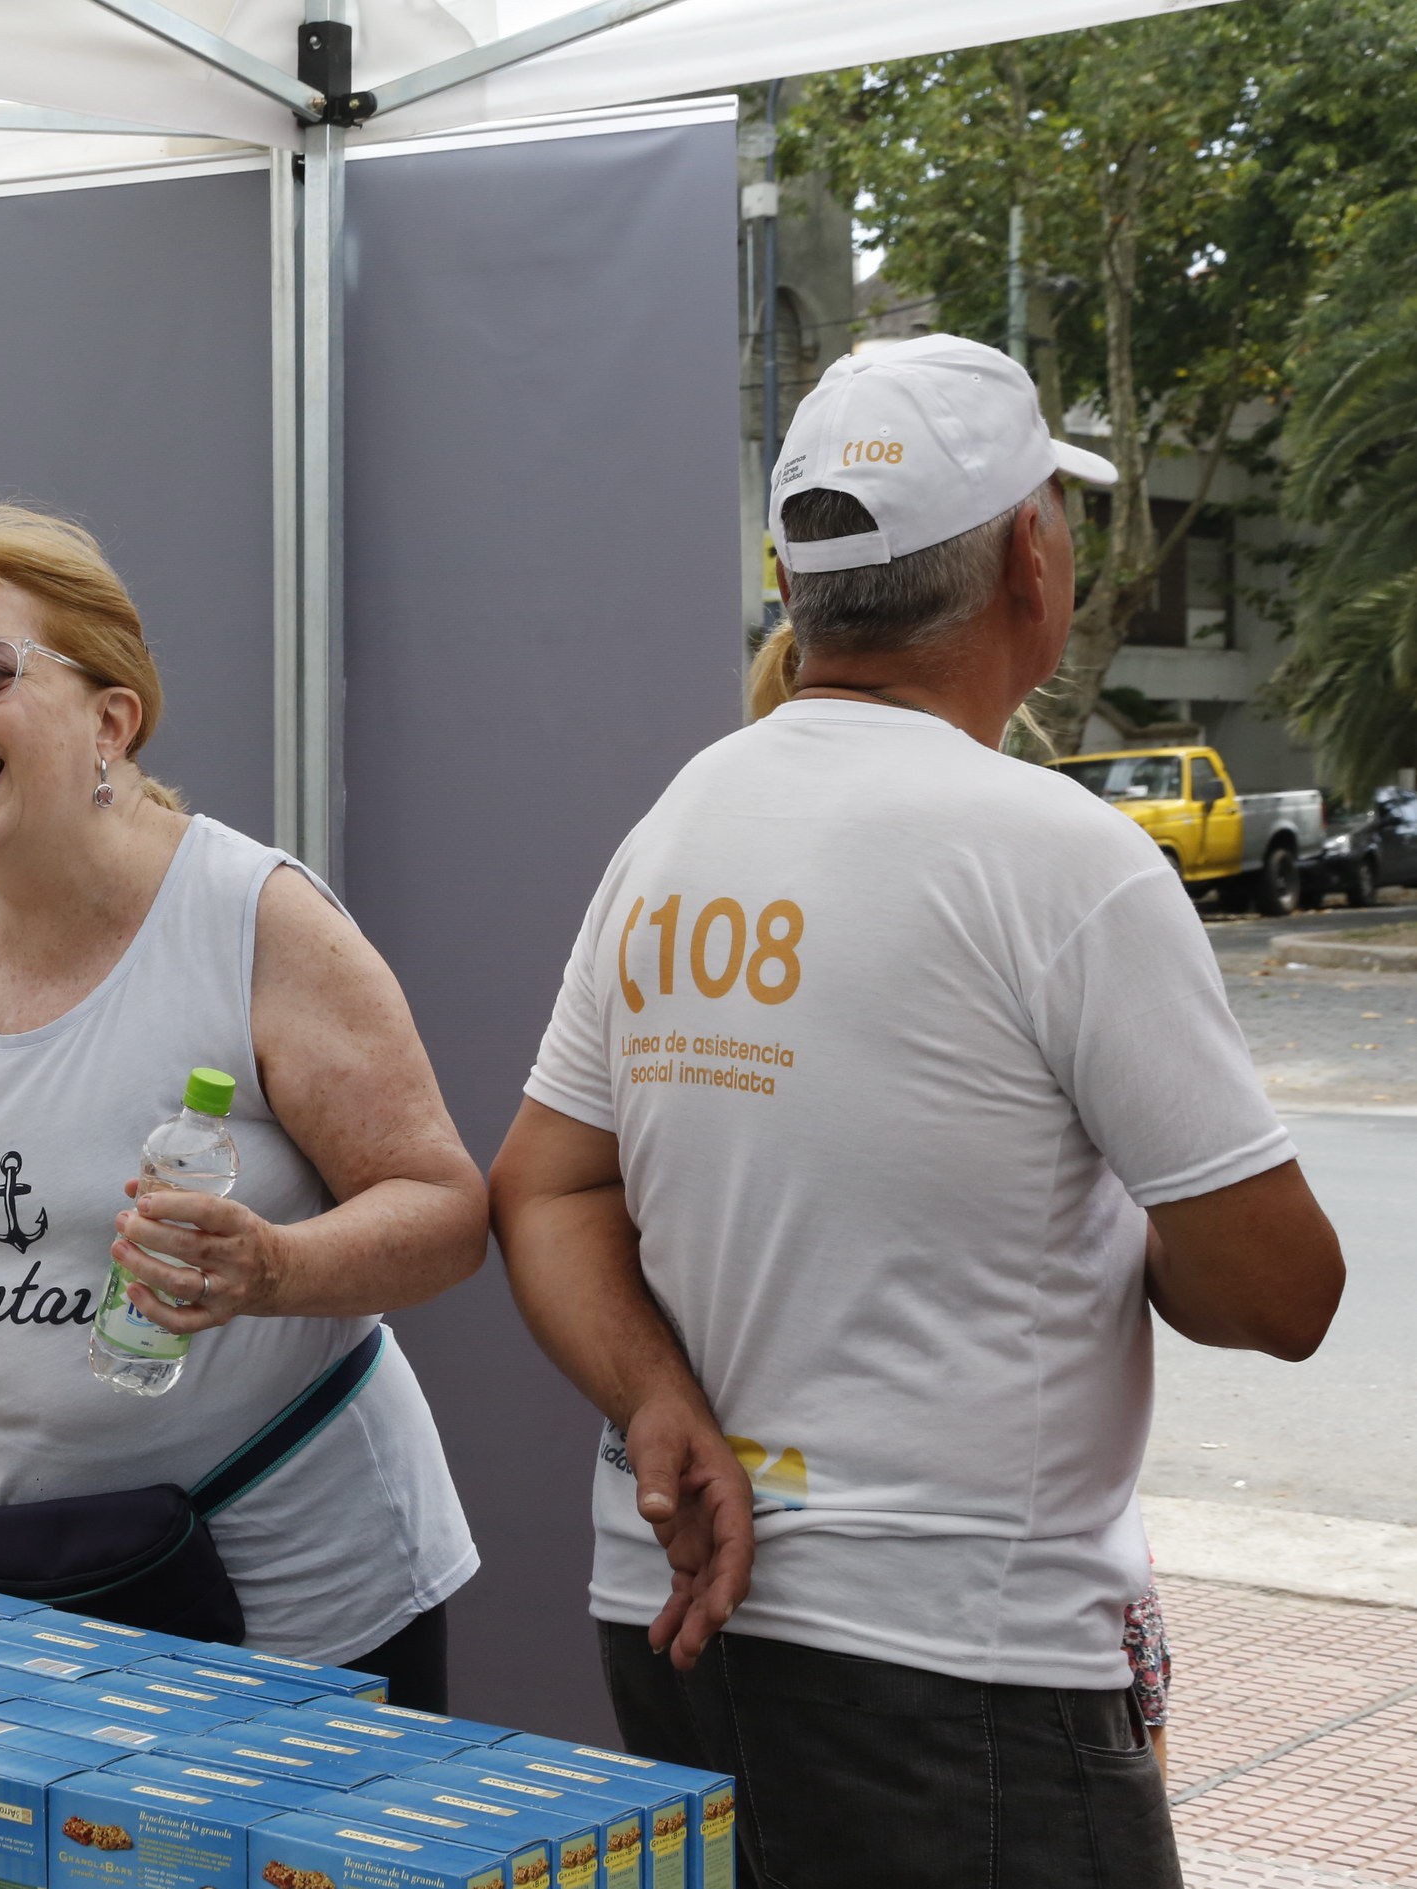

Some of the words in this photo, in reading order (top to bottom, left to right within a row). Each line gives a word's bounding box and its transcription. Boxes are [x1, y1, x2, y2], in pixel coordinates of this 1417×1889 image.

[854, 440, 904, 465] 108
[649, 894, 804, 1005] 108
[621, 1033, 660, 1057] Línea
[664, 1030, 687, 1053] de
[692, 1035, 795, 1068] asistencia
[631, 1059, 673, 1084] social
[679, 1062, 776, 1095] inmediata
[138, 1823, 143, 1832] y
[145, 1822, 157, 1832] los
[158, 1828, 190, 1840] cereales
[139, 1811, 179, 1827] Beneficios
[180, 1820, 190, 1830] de
[191, 1822, 199, 1832] la
[200, 1828, 232, 1839] granola
[343, 1869, 348, 1879] y
[350, 1869, 363, 1880] los
[365, 1875, 400, 1888] cereales
[344, 1856, 388, 1873] Beneficios
[389, 1867, 400, 1877] de
[401, 1869, 409, 1880] la
[411, 1874, 445, 1888] granola
